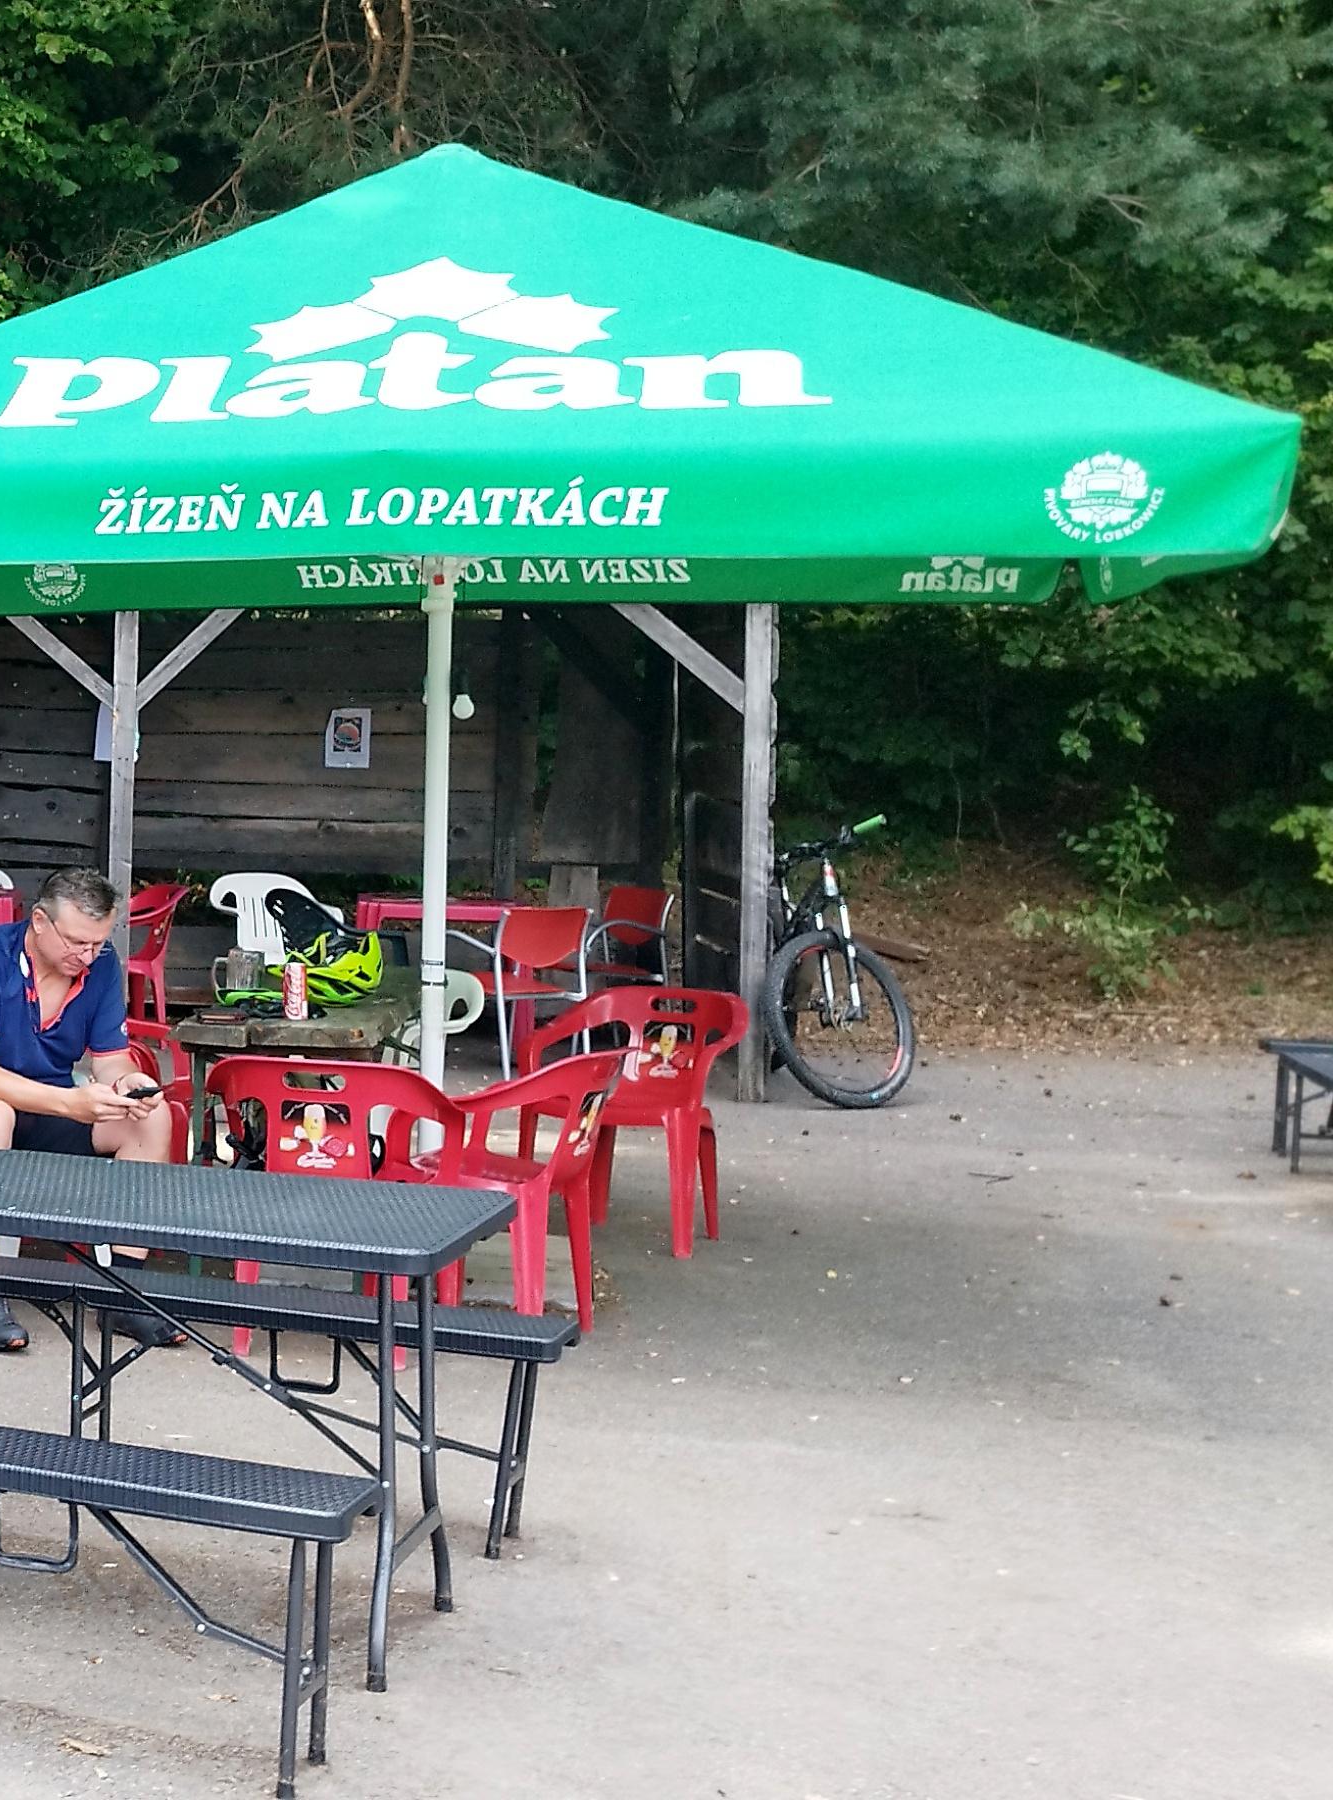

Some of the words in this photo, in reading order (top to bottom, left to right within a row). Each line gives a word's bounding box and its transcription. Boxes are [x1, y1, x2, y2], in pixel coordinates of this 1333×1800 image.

[94, 484, 246, 535] ŽÍZEŇ
[255, 490, 329, 529] NA
[345, 476, 669, 526] LOPATKÁCH
